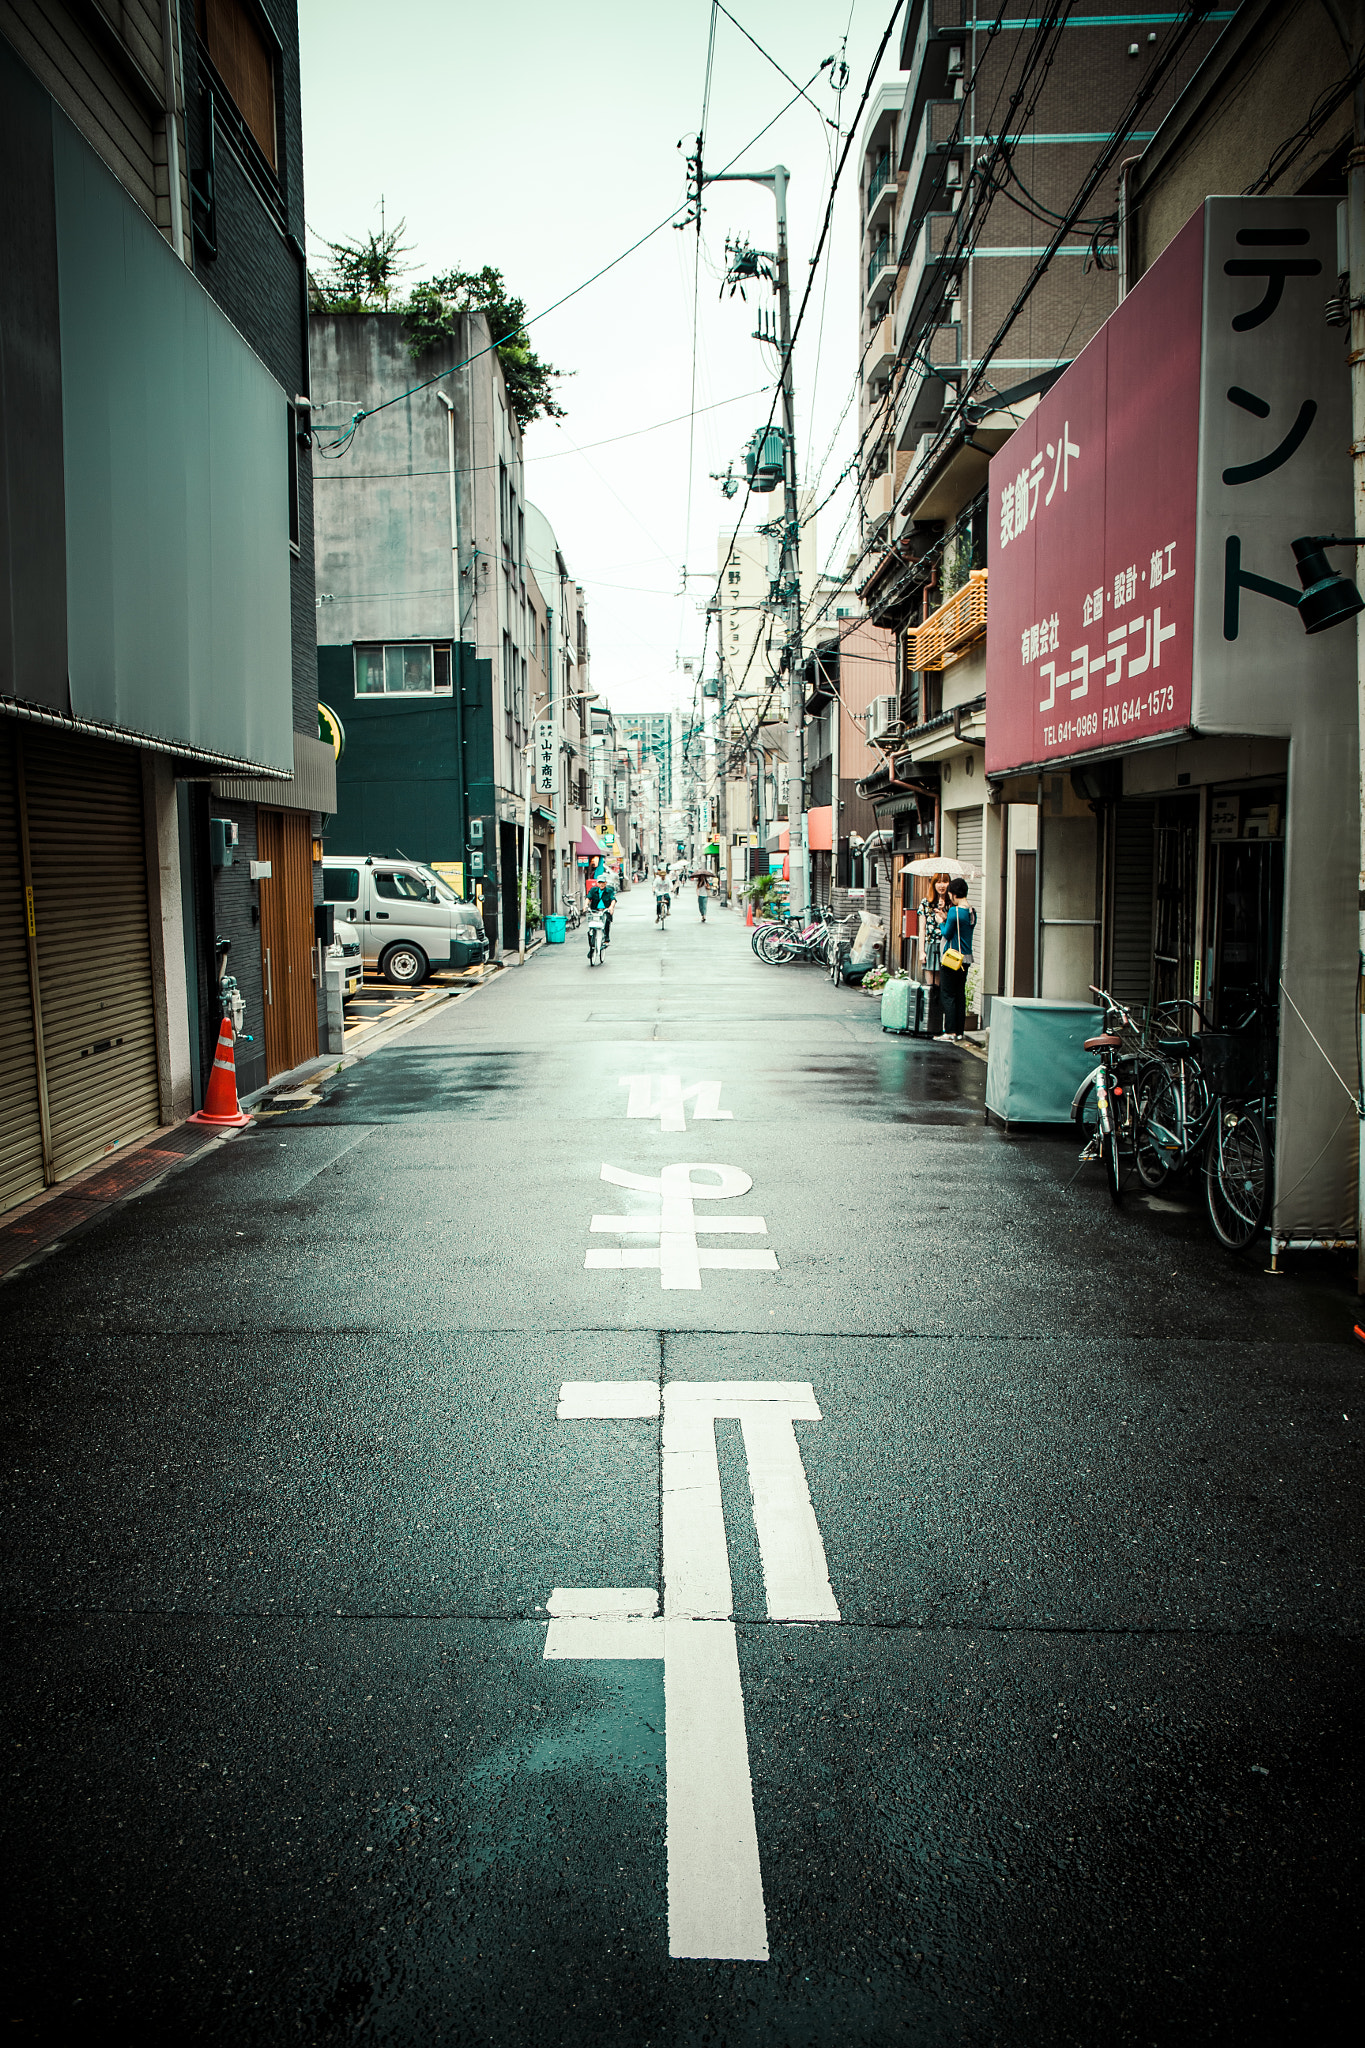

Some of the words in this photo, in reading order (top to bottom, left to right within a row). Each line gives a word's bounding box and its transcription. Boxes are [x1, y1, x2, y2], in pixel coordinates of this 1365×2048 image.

[1221, 228, 1323, 642] テント
[999, 420, 1081, 549] 装飾テント
[1020, 613, 1060, 666] 有限会社
[1038, 606, 1177, 712] コーヨーテント
[1043, 726, 1057, 746] TEL
[1057, 713, 1098, 743] 641-0969
[1102, 705, 1120, 730] FAX
[1121, 684, 1175, 725] 644-1573
[541, 739, 552, 789] 山市商店
[601, 825, 608, 834] P
